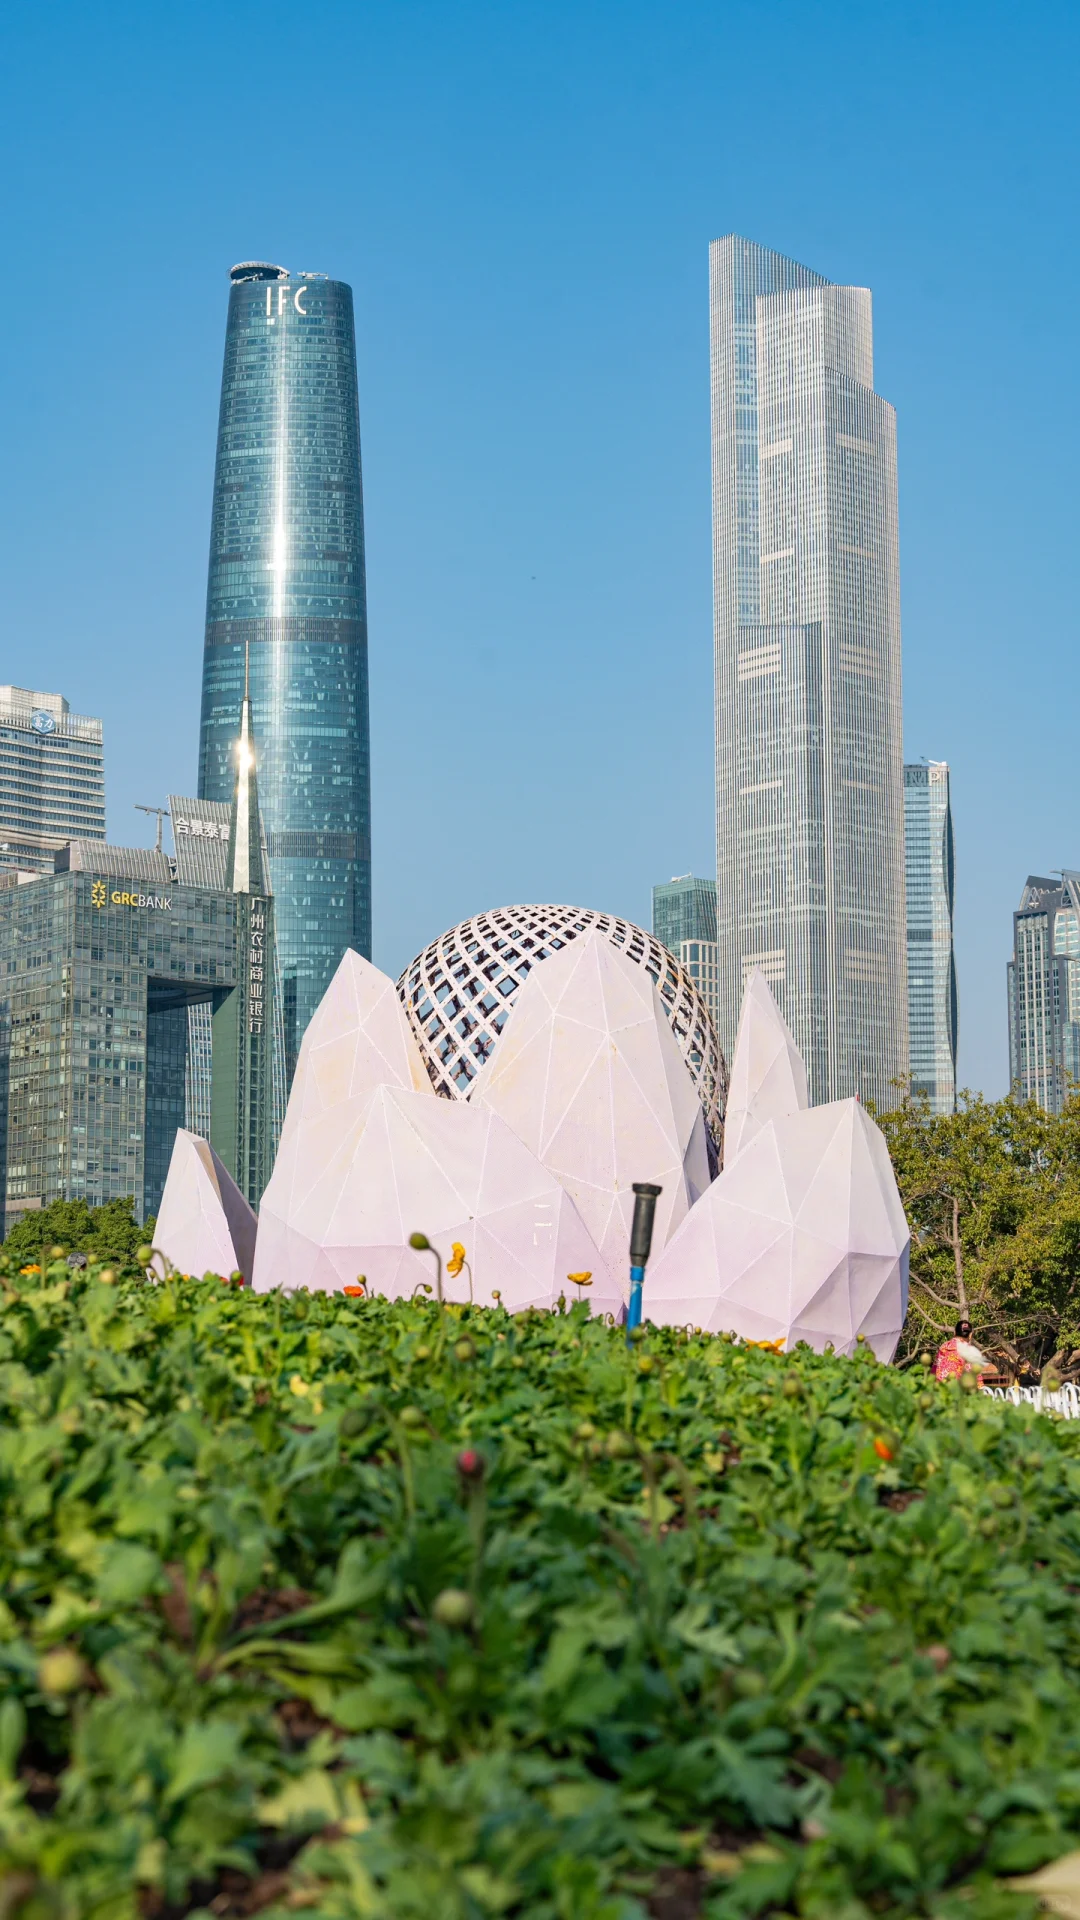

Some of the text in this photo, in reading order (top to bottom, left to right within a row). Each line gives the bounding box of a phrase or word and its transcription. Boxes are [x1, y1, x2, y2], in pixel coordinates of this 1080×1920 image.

[266, 286, 307, 316] IFC
[33, 714, 53, 729] 富力
[111, 891, 172, 911] GRCBANK
[249, 896, 267, 1034] 广州农村商业银行
